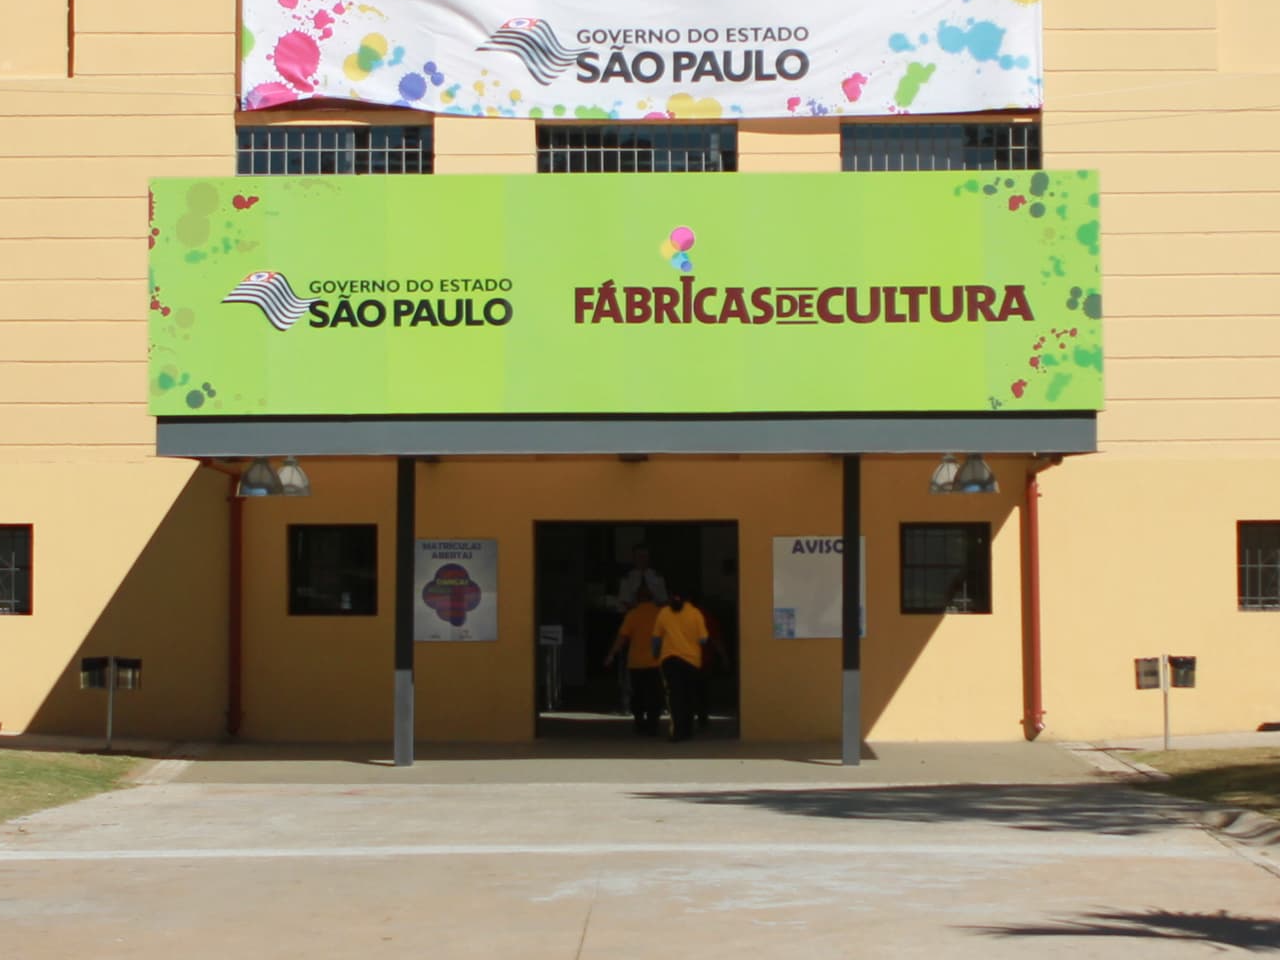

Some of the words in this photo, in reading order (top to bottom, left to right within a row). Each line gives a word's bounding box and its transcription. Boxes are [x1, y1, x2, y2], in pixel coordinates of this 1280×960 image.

[576, 28, 681, 44] GOVERNO
[687, 28, 719, 44] DO
[726, 26, 809, 42] ESTADO
[575, 45, 665, 84] SÃO
[672, 48, 810, 83] PAULO
[309, 280, 400, 294] GOVERNO
[406, 279, 434, 293] DO
[439, 278, 513, 292] ESTADO
[574, 275, 774, 324] FÁBRICAS
[817, 285, 1035, 324] CULTURA
[308, 294, 387, 328] SÃO
[393, 297, 514, 327] PAULO
